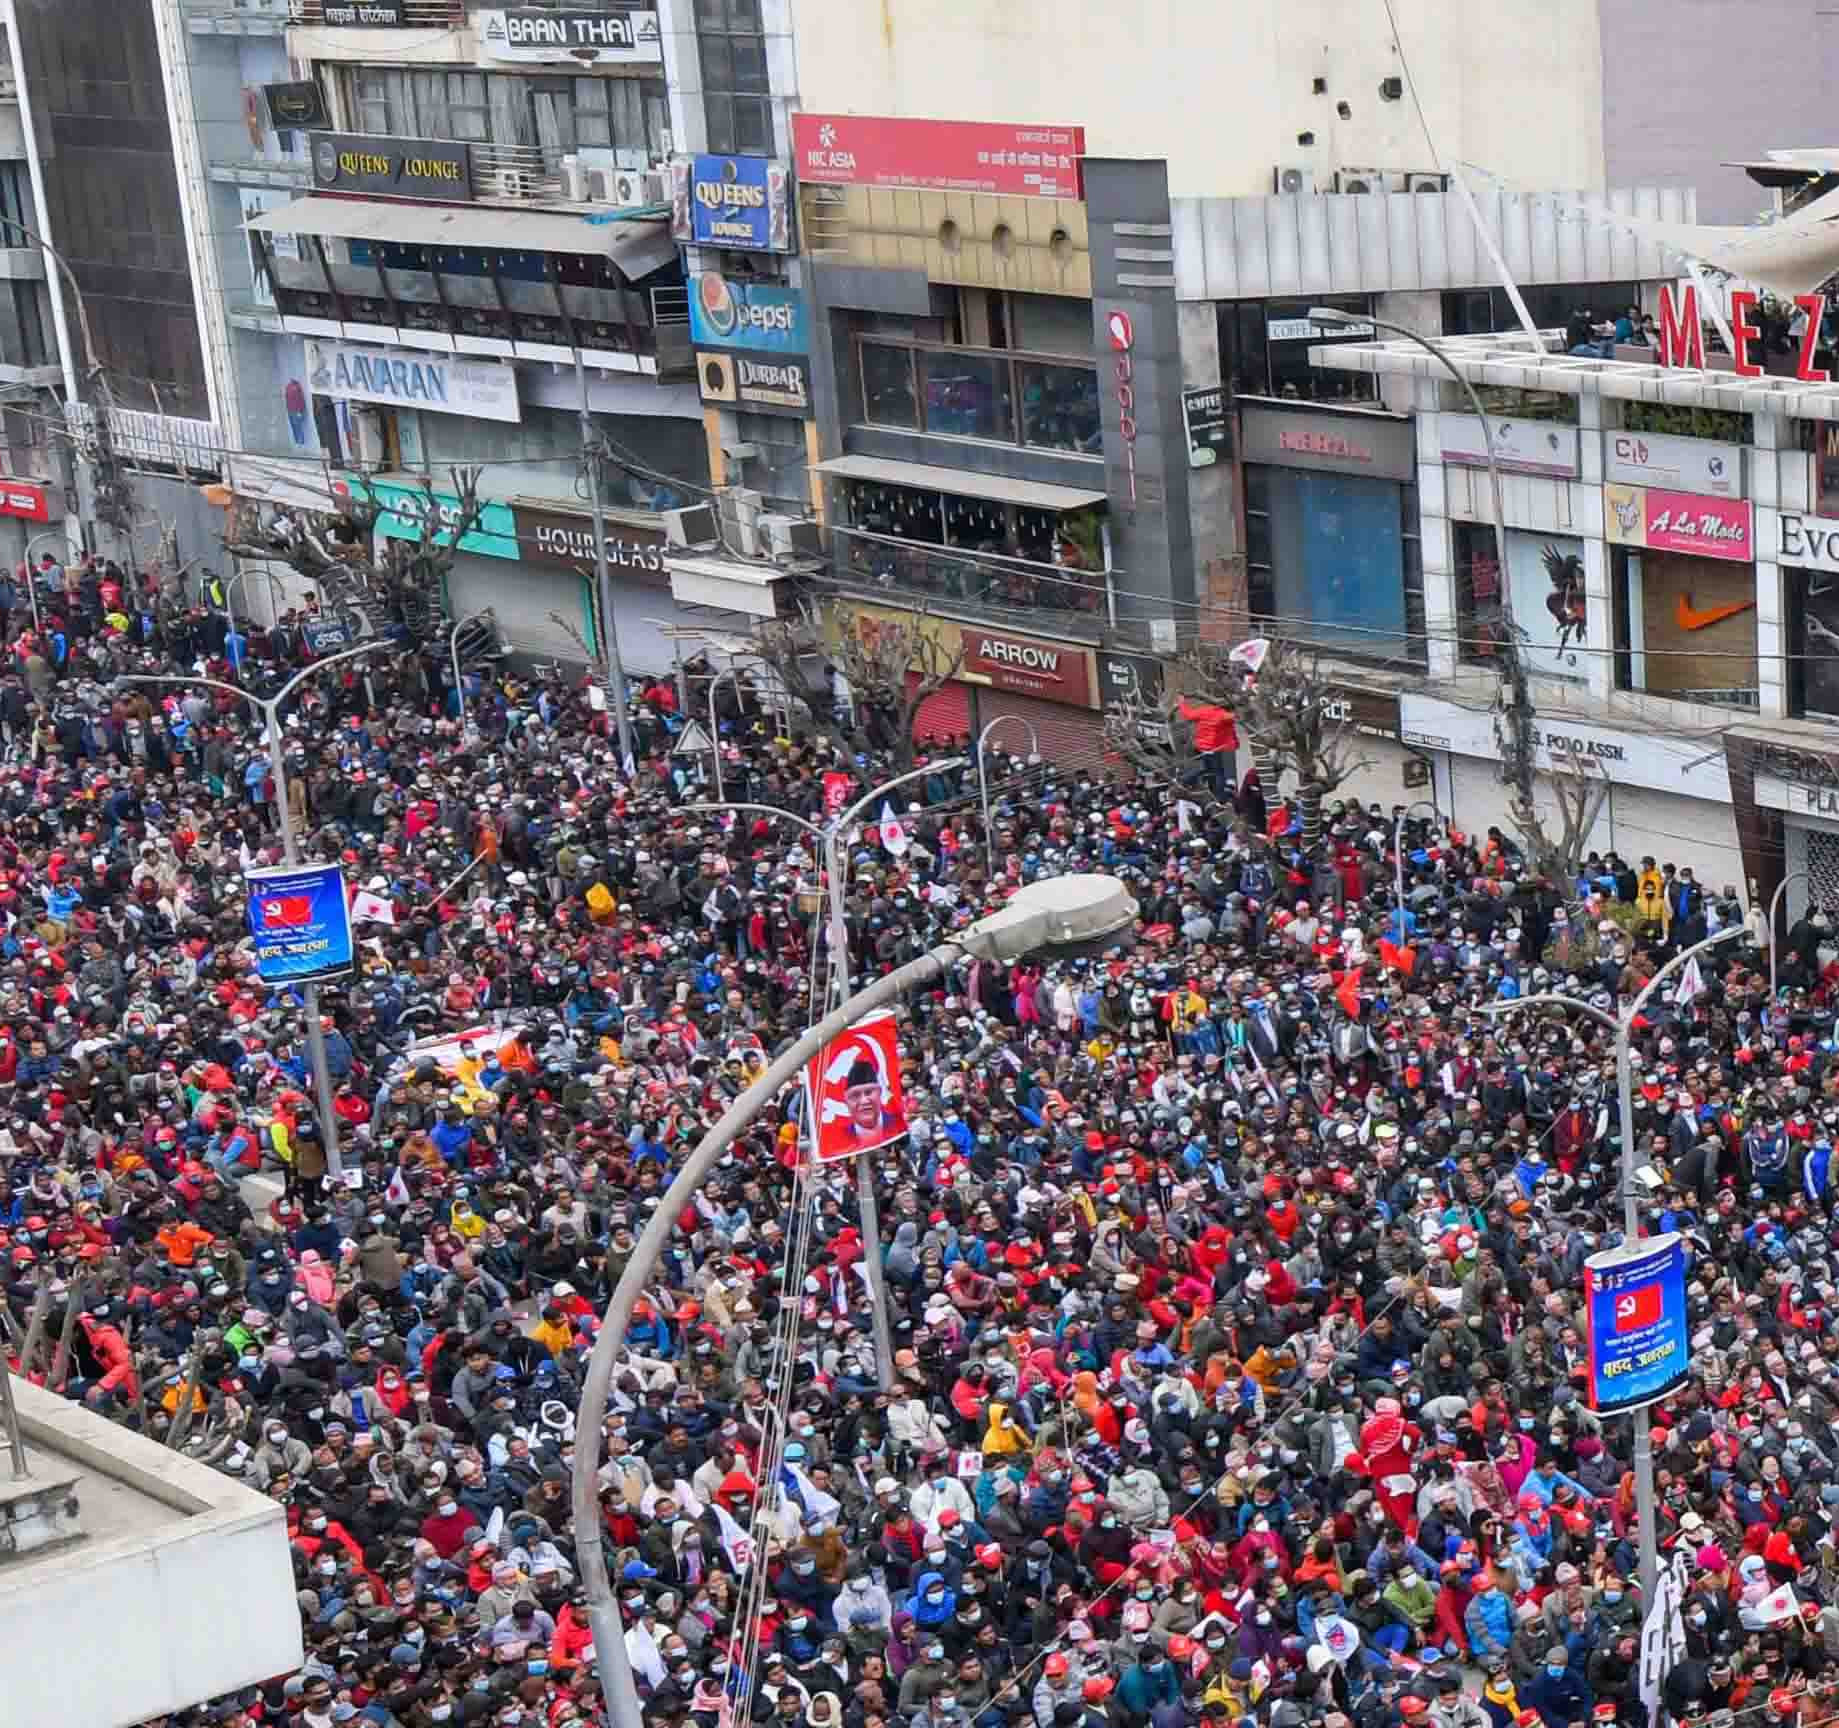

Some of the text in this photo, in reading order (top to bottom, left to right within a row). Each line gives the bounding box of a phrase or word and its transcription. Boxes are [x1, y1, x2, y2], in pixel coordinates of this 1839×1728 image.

[507, 16, 633, 43] BAAN THAI
[339, 151, 460, 181] QUEENS LOUNGE
[829, 152, 856, 169] ASIA
[696, 182, 764, 209] QUEENS
[737, 304, 796, 335] pepsi
[335, 352, 449, 403] AAVARAN
[737, 361, 802, 393] DURBAR
[1649, 510, 1670, 534] A
[1671, 511, 1697, 536] La
[1698, 515, 1745, 542] Mode
[980, 639, 1058, 671] ARROW
